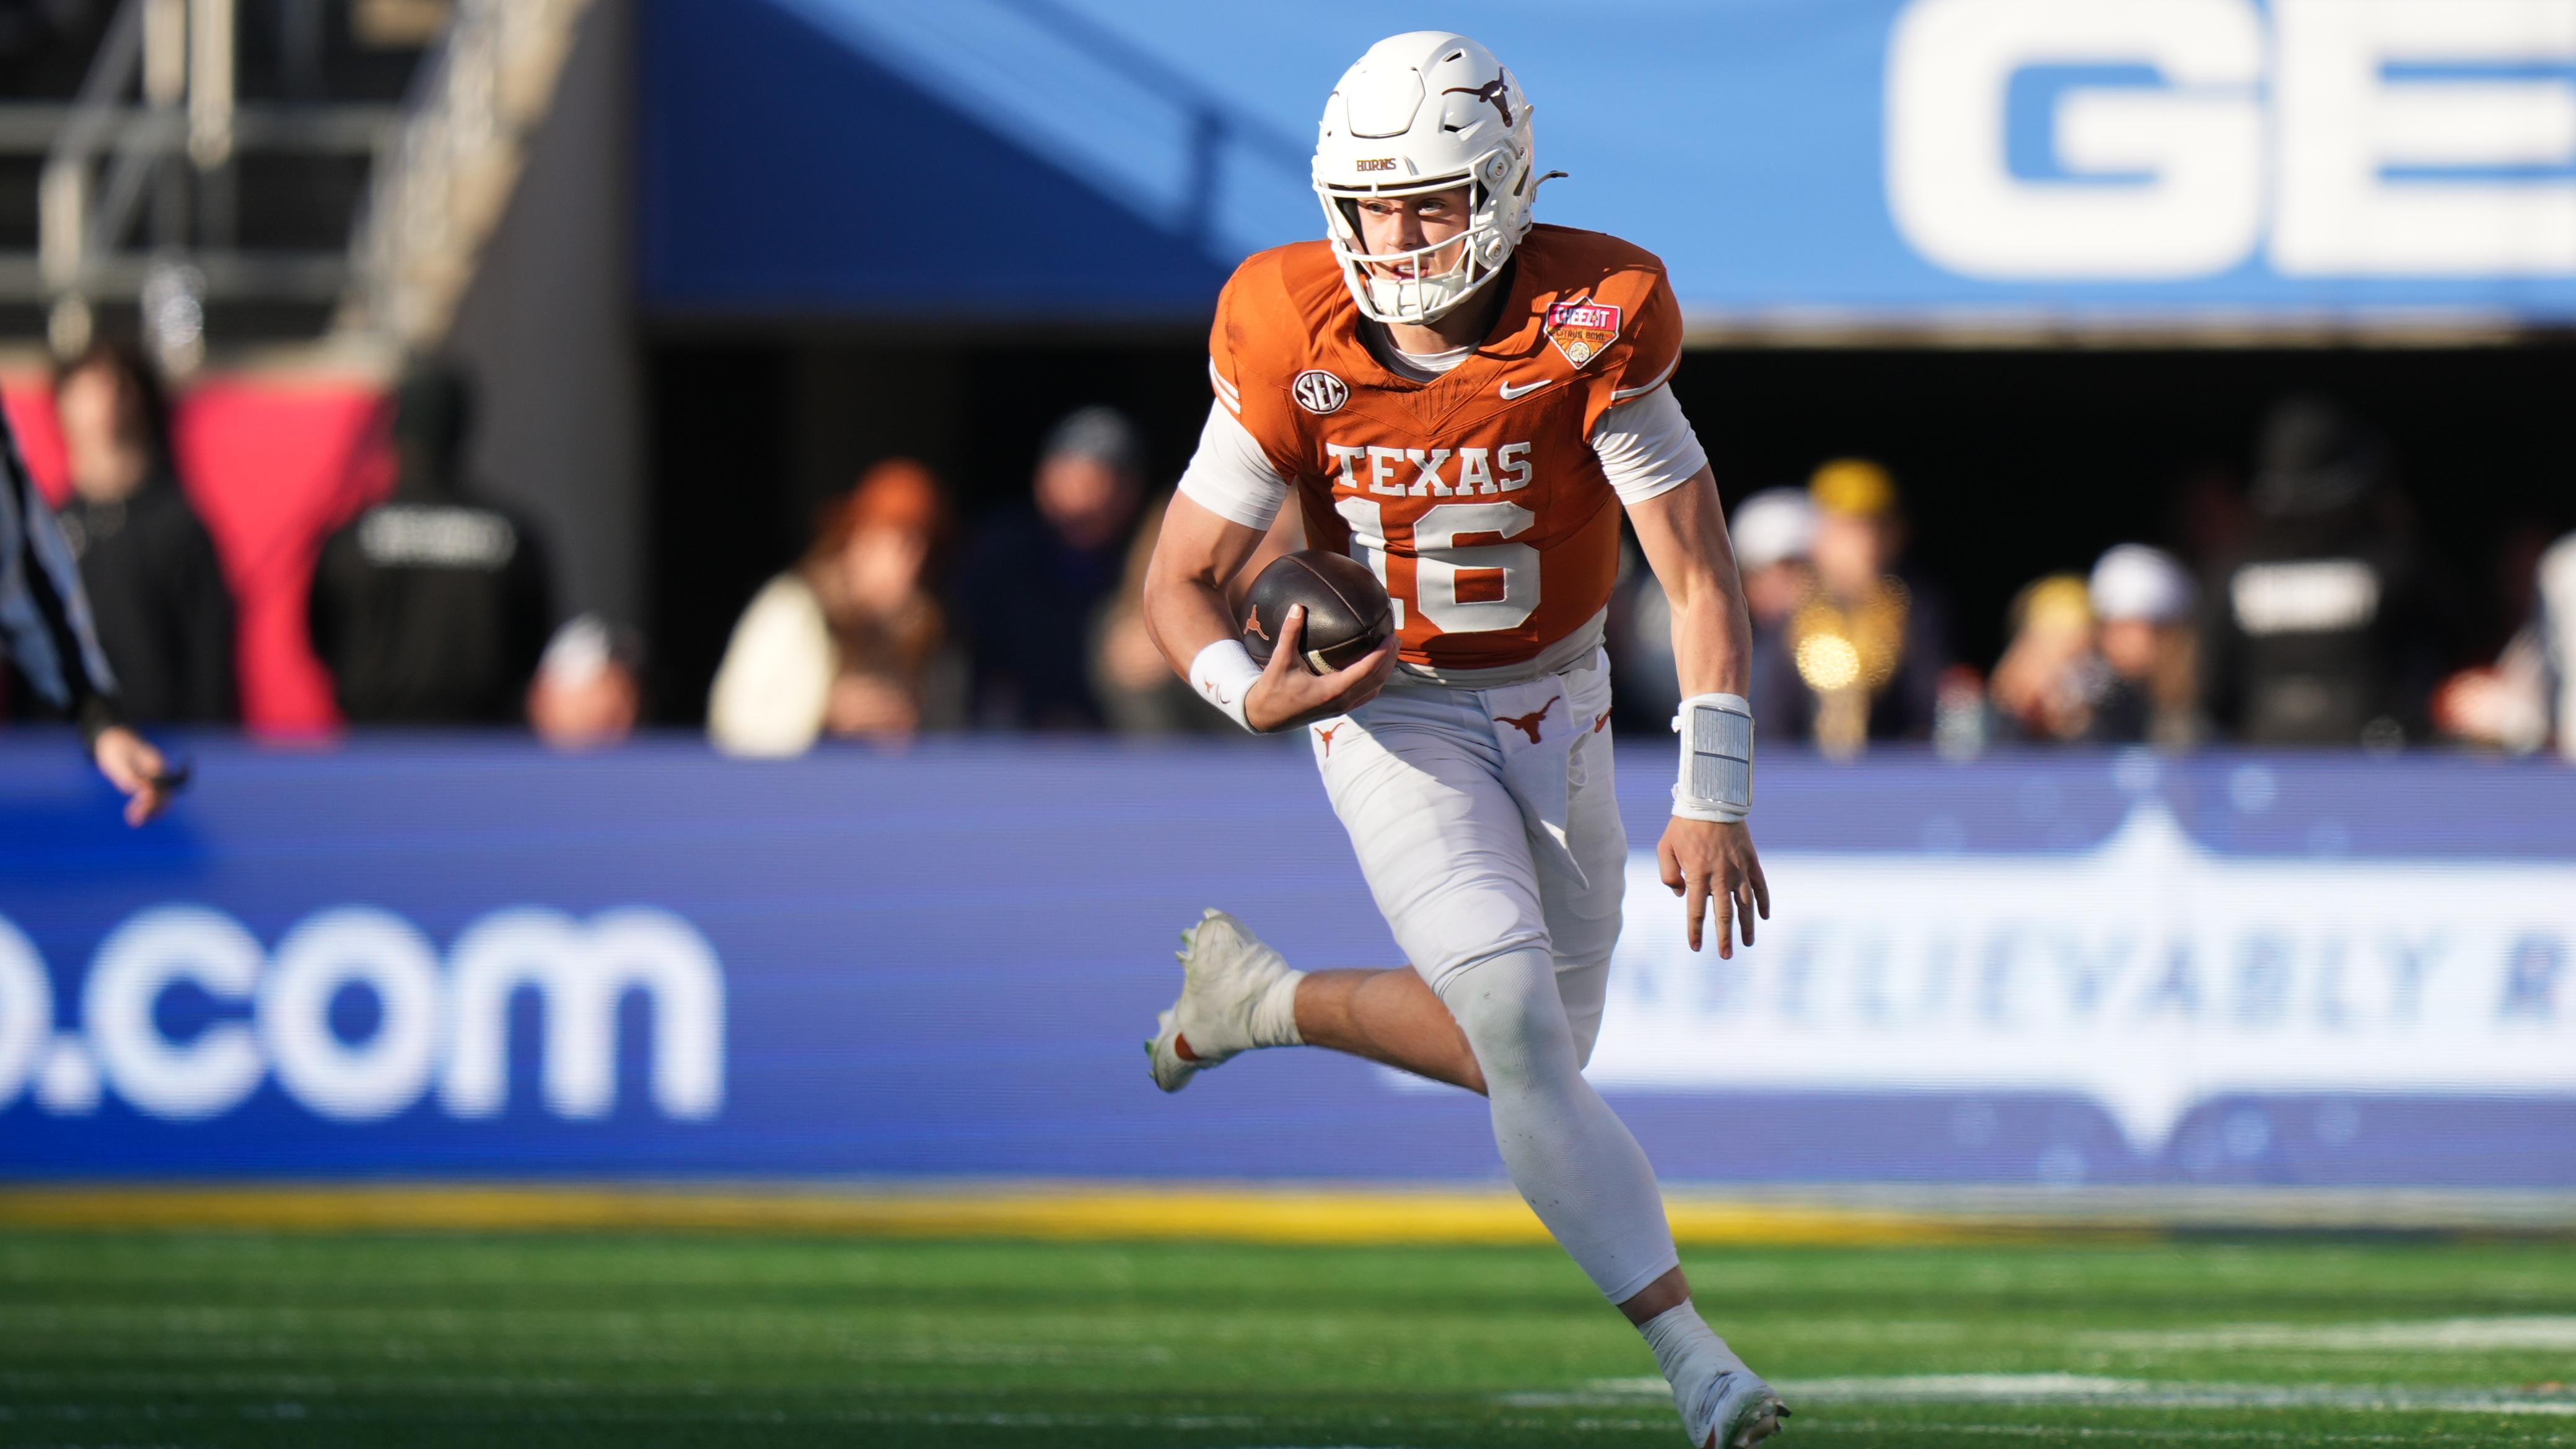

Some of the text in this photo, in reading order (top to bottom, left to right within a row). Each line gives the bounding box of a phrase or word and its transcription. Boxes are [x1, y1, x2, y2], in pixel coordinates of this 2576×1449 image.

[1586, 332, 1605, 340] BOWL
[1297, 374, 1343, 411] SEC
[1326, 442, 1532, 497] TEXAS
[1335, 496, 1541, 633] 16
